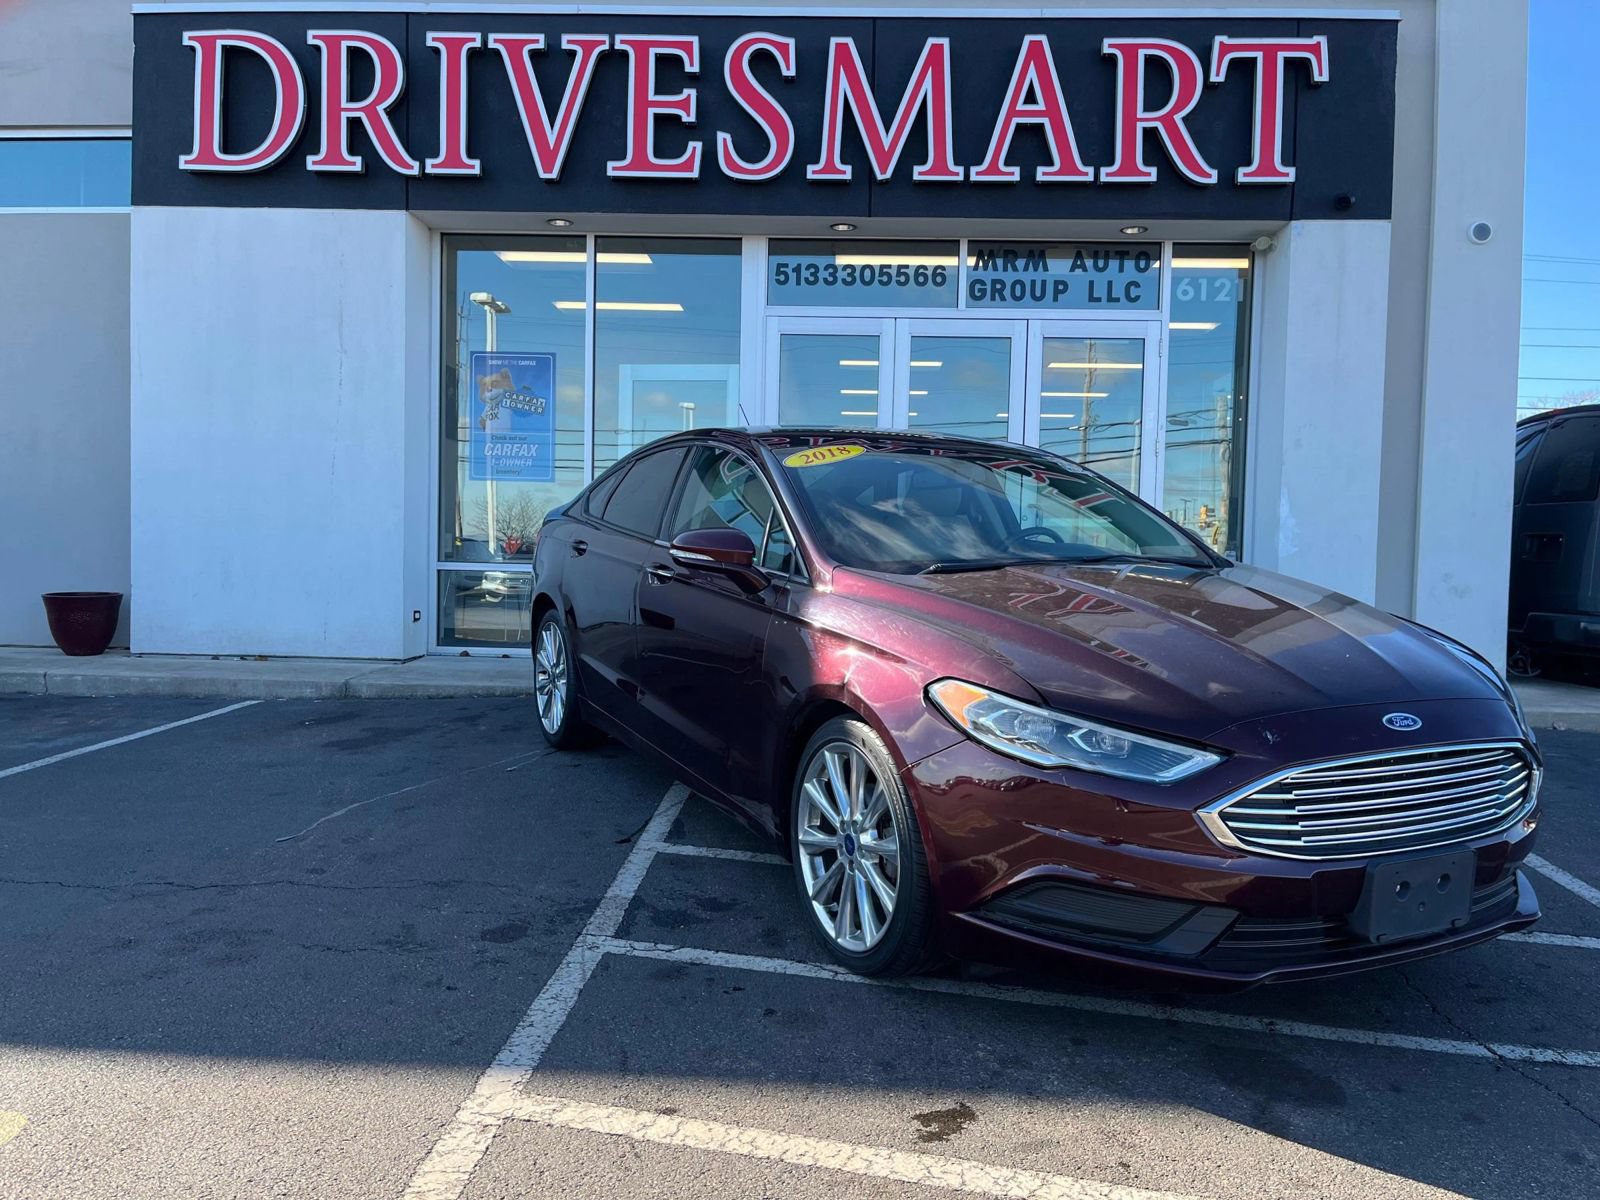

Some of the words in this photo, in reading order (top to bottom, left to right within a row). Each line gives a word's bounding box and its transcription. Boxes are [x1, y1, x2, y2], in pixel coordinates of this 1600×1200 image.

[179, 29, 1330, 185] DRIVESMART
[972, 249, 1050, 273] MRM
[1069, 249, 1151, 274] AUTO
[774, 262, 947, 288] 5133305566
[968, 278, 1070, 303] GROUP
[1087, 279, 1142, 304] LLC
[505, 392, 546, 406] CARFAX
[510, 402, 543, 414] OWNER
[484, 443, 538, 457] CARFAX
[799, 446, 851, 464] 2018
[1391, 716, 1414, 727] Ford
